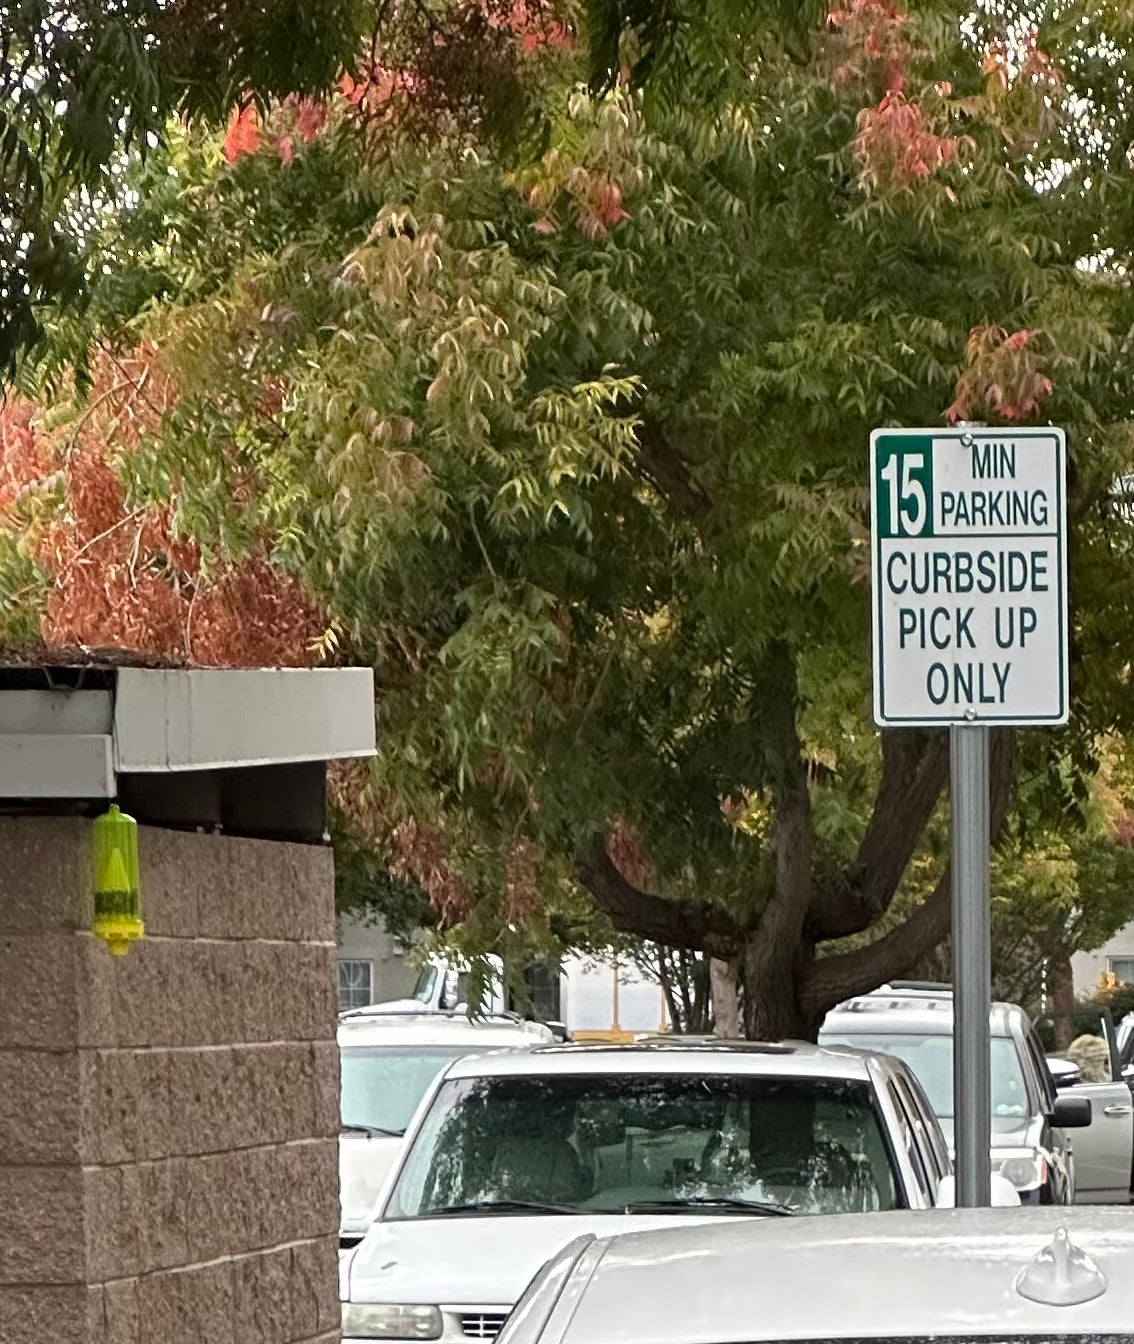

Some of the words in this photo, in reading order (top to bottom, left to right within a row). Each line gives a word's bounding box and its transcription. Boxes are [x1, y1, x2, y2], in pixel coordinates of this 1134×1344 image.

[971, 444, 1016, 479] MIN
[881, 453, 927, 536] 15
[941, 490, 1048, 526] PARKING
[887, 550, 1048, 594] CURBSIDE
[900, 607, 976, 649] PICK
[995, 607, 1037, 648] UP
[927, 662, 1011, 705] ONLY
